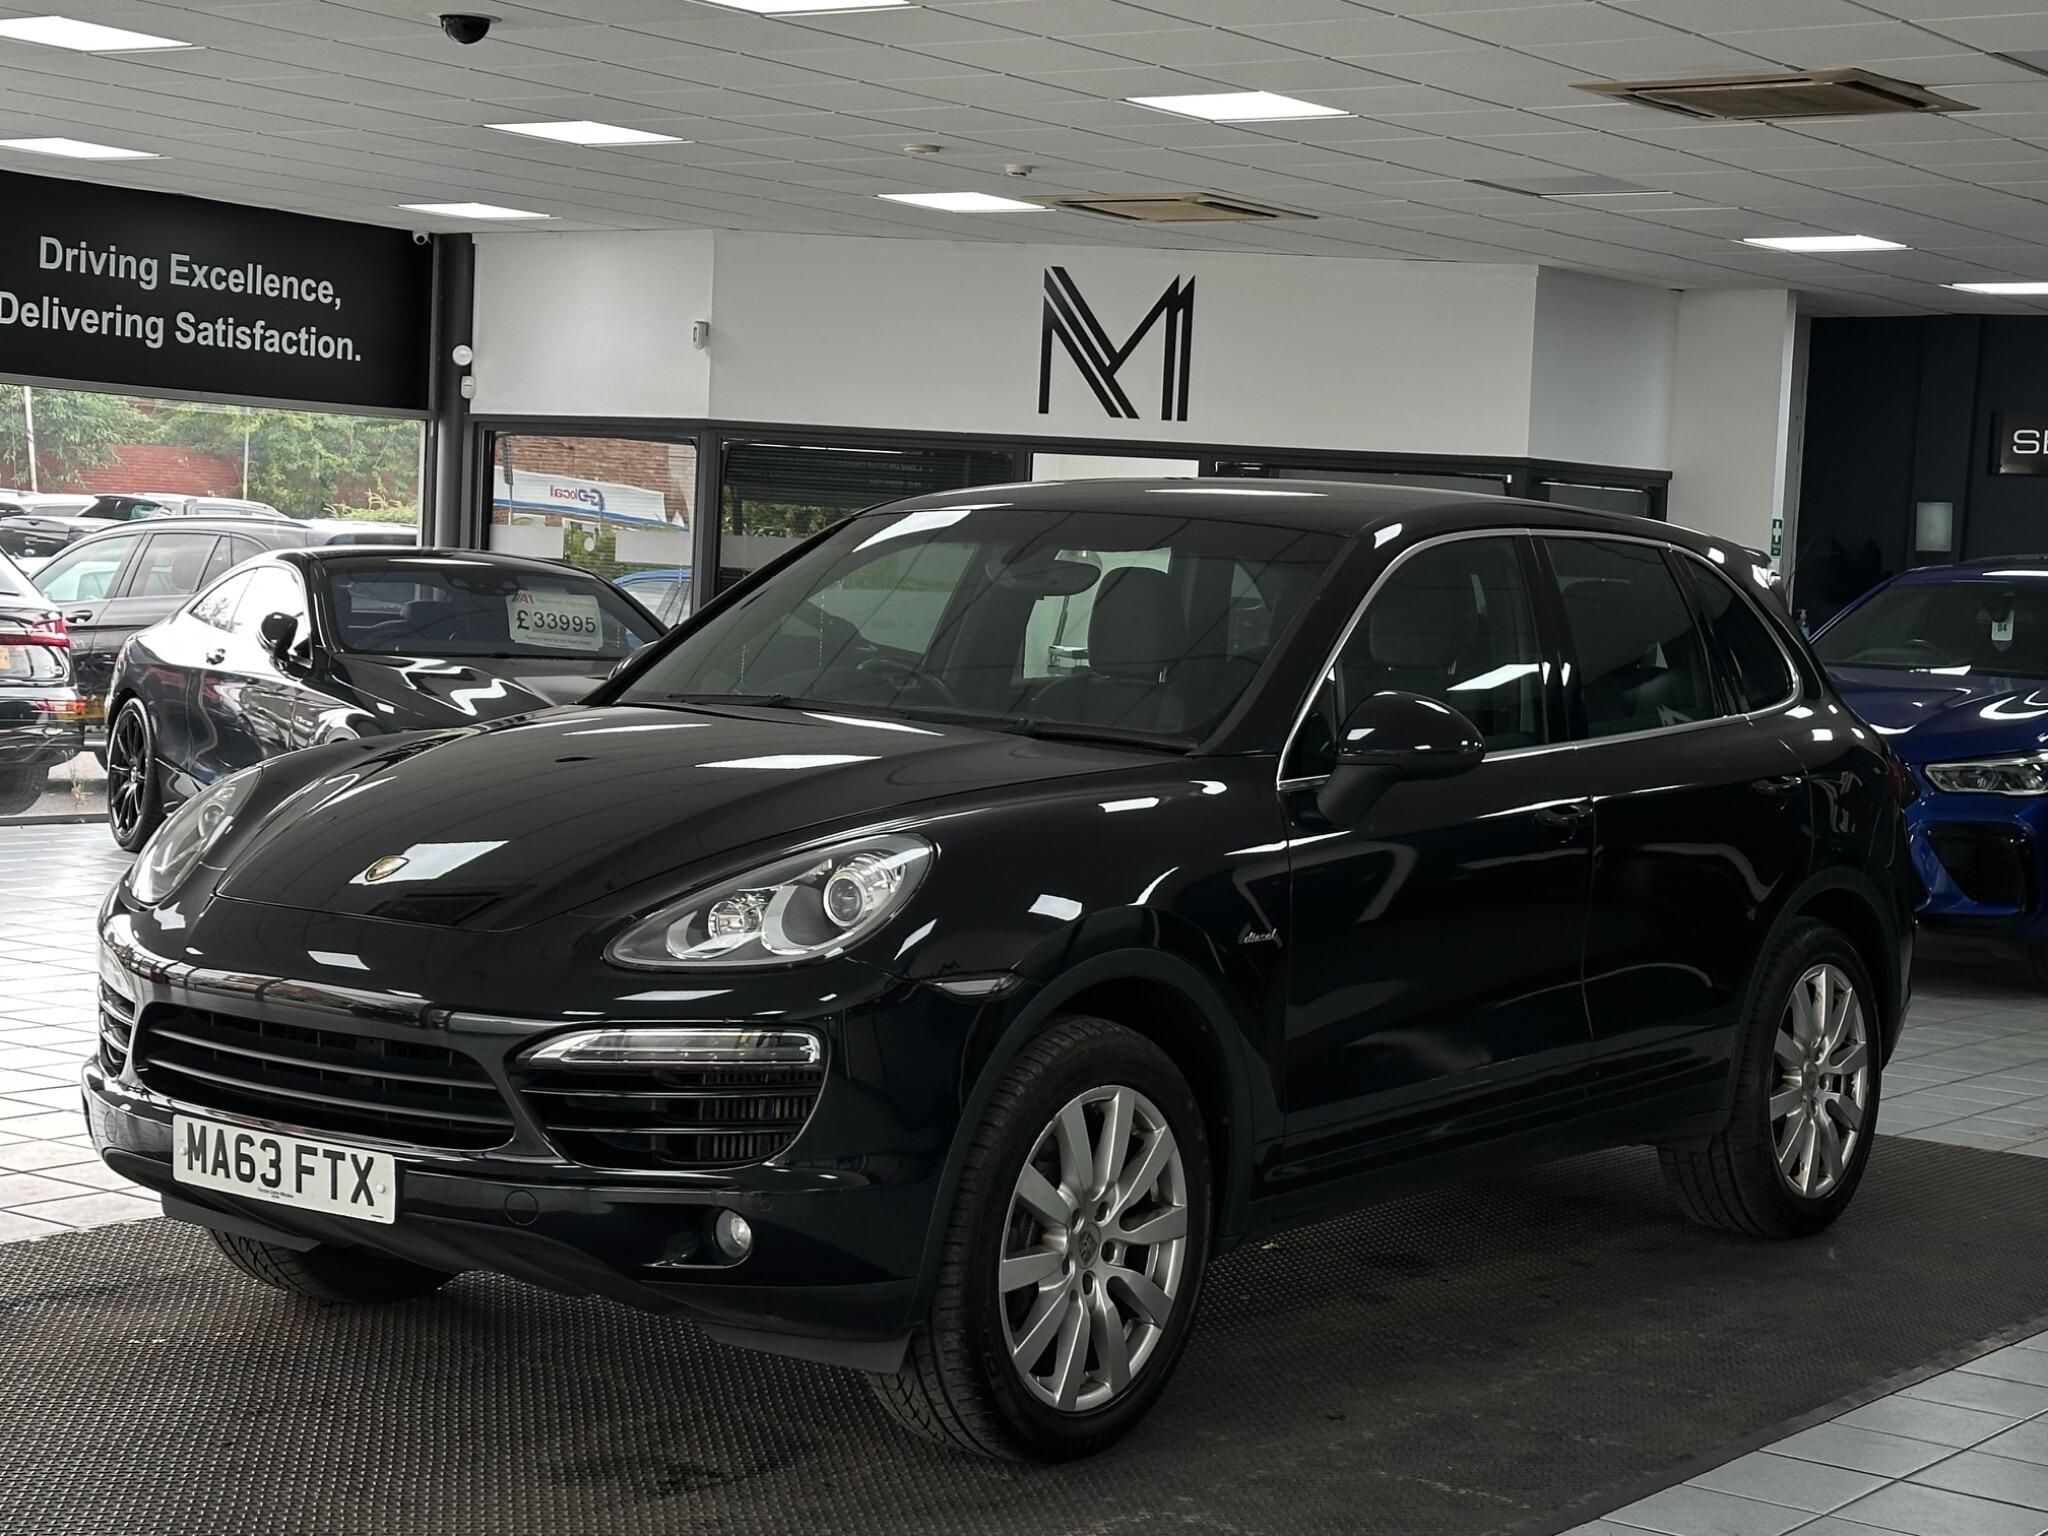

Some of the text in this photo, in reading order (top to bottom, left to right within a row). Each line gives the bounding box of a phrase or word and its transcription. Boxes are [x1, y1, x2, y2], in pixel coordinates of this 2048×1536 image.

[39, 236, 341, 311] Driving Excellence,
[0, 291, 361, 361] Delivering Satisfaction.
[2013, 429, 2048, 454] S
[516, 610, 596, 633] £33995
[187, 1122, 374, 1207] MA63 FTX
